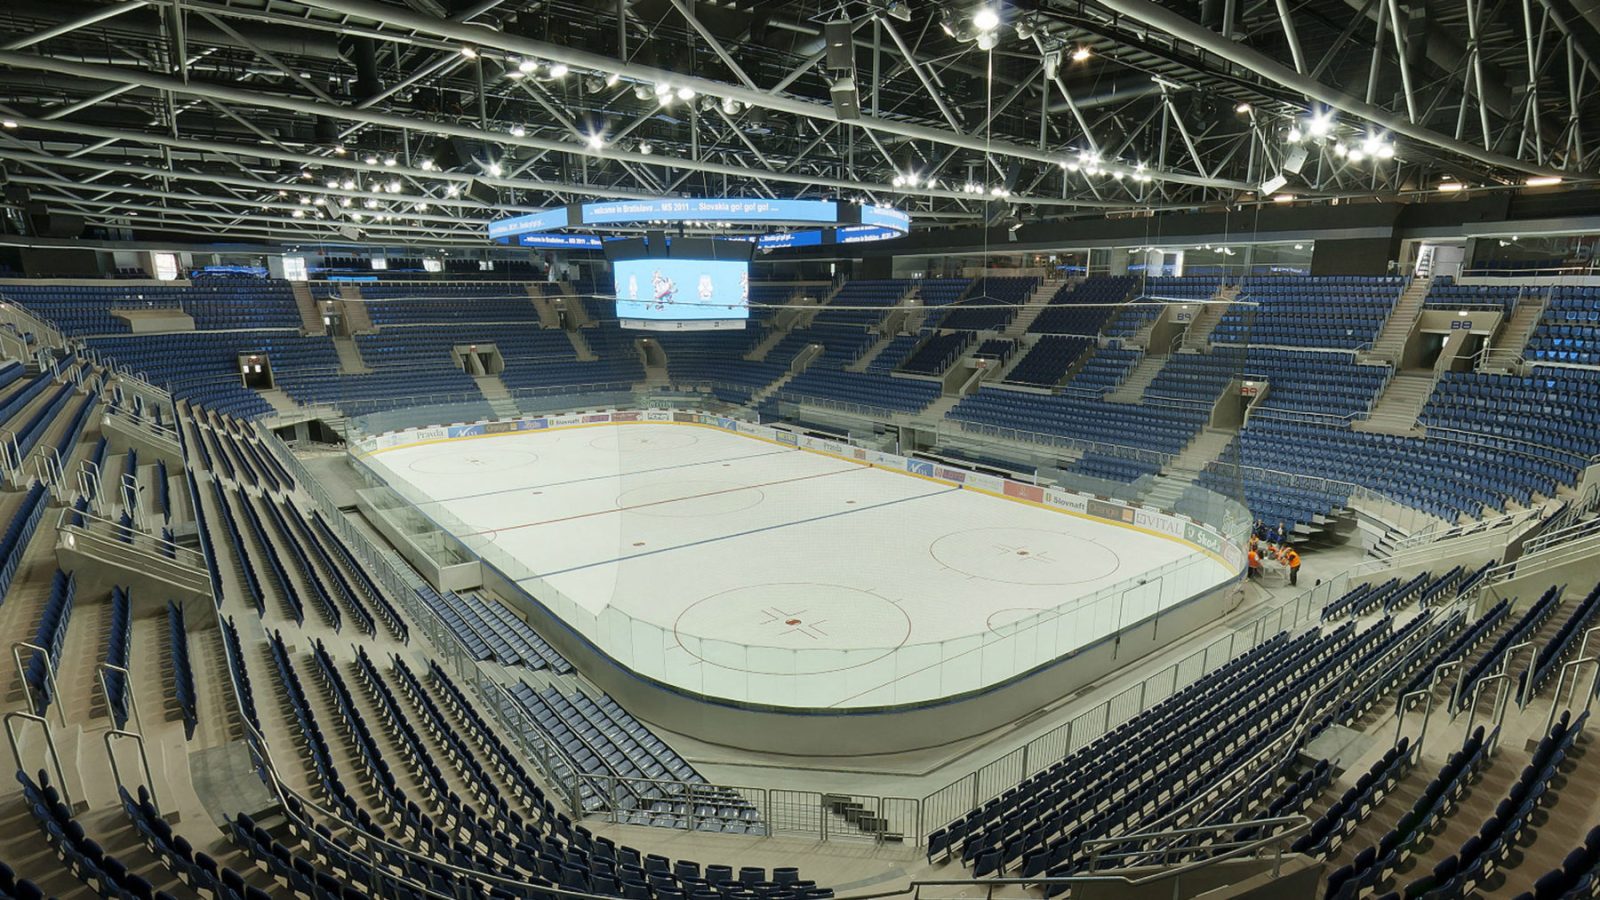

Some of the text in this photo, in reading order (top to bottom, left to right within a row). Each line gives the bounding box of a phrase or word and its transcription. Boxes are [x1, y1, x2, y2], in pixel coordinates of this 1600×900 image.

[661, 202, 673, 211] MS
[674, 202, 689, 211] 2011
[699, 202, 729, 211] Slovakia
[730, 202, 742, 212] go!
[744, 202, 756, 212] go!
[757, 202, 769, 212] go!
[1177, 312, 1192, 320] B9
[1053, 496, 1085, 510] Slovnaft
[1145, 516, 1181, 535] VITAL
